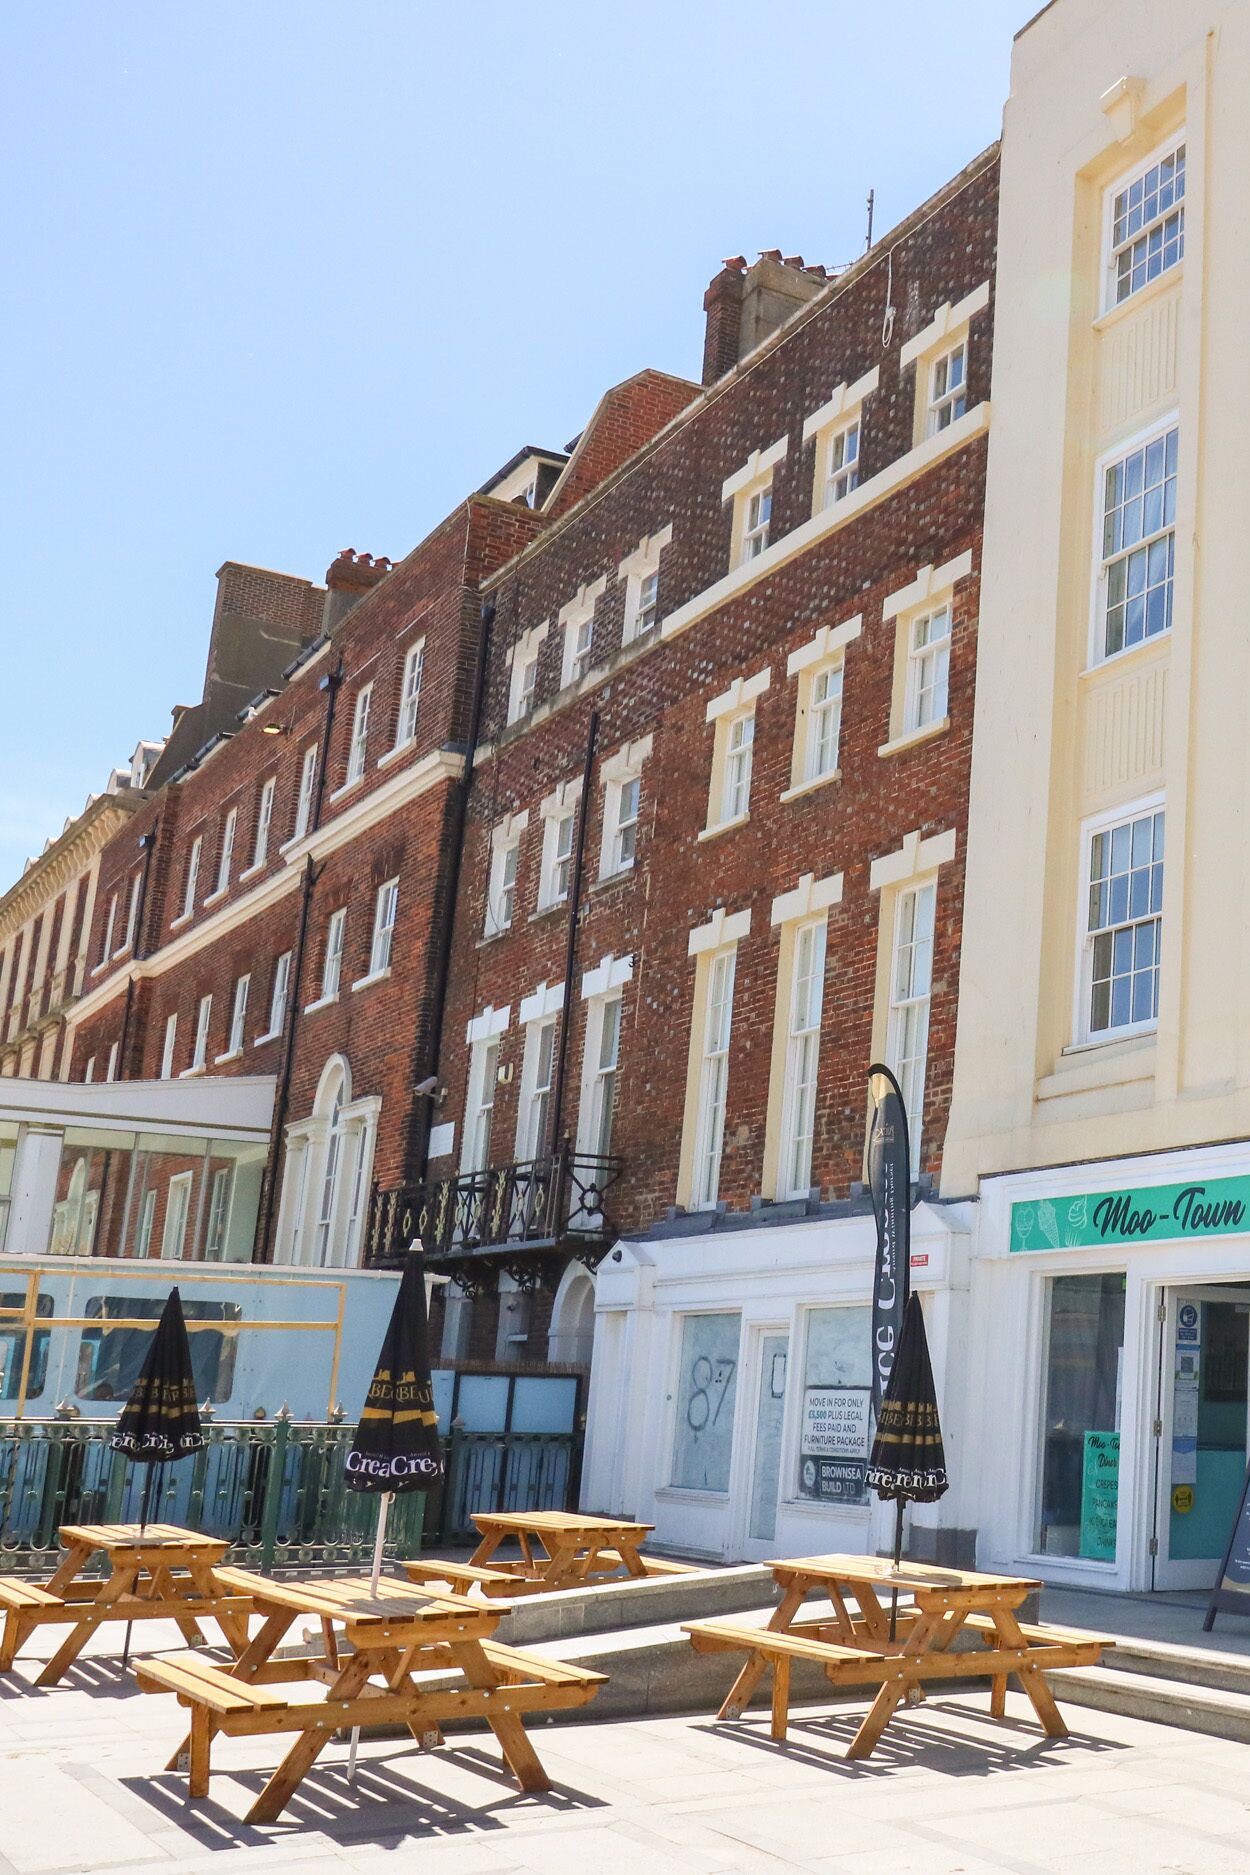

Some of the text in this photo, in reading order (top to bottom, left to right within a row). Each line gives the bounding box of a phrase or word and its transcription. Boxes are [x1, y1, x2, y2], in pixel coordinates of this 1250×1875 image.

[1093, 1187, 1246, 1238] Moo-Town
[687, 1356, 736, 1432] 87
[809, 1397, 864, 1408] MOVE IN FOR ONLY
[808, 1410, 863, 1420] £5,500 PLUS LEGAL
[813, 1423, 856, 1433] FEES PAID AND
[804, 1434, 865, 1447] FURNITURE PACKAGE
[346, 1451, 391, 1477] Crea
[821, 1465, 861, 1480] BROWNSEA
[822, 1480, 856, 1494] BUILD LTD
[1096, 1480, 1118, 1490] CREPES
